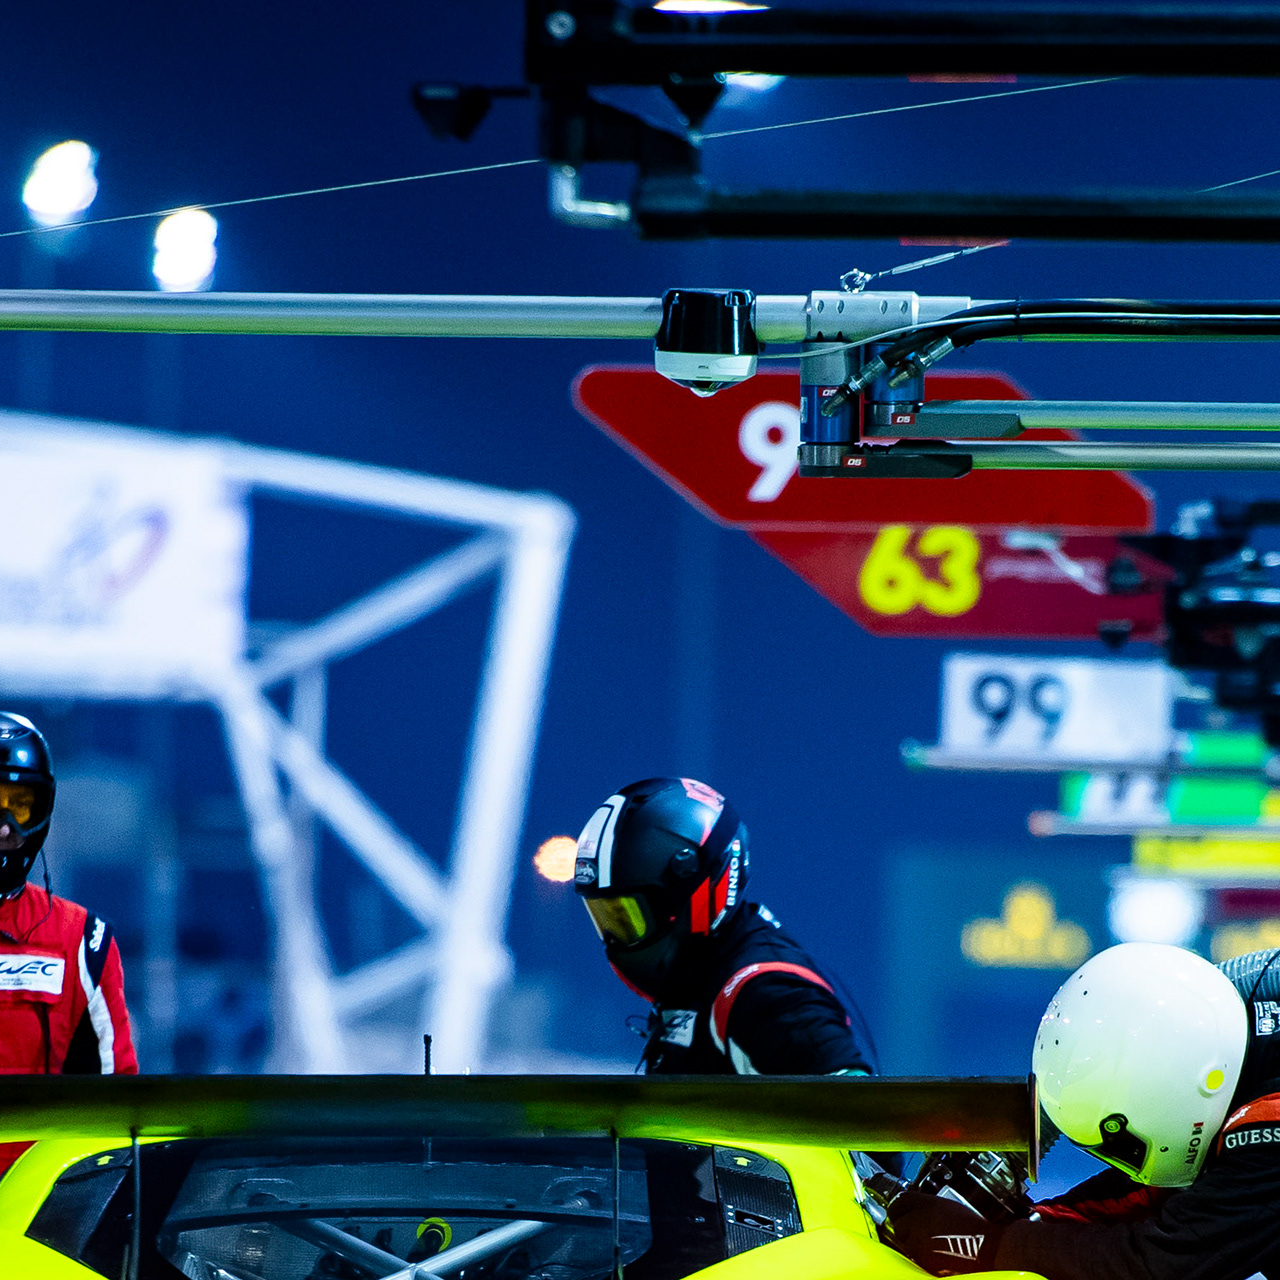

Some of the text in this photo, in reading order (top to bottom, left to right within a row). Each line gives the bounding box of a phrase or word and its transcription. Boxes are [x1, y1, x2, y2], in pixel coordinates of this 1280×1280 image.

[738, 400, 803, 503] 9
[859, 523, 982, 618] 63
[971, 670, 1068, 748] 99
[1184, 1137, 1201, 1165] ALFO
